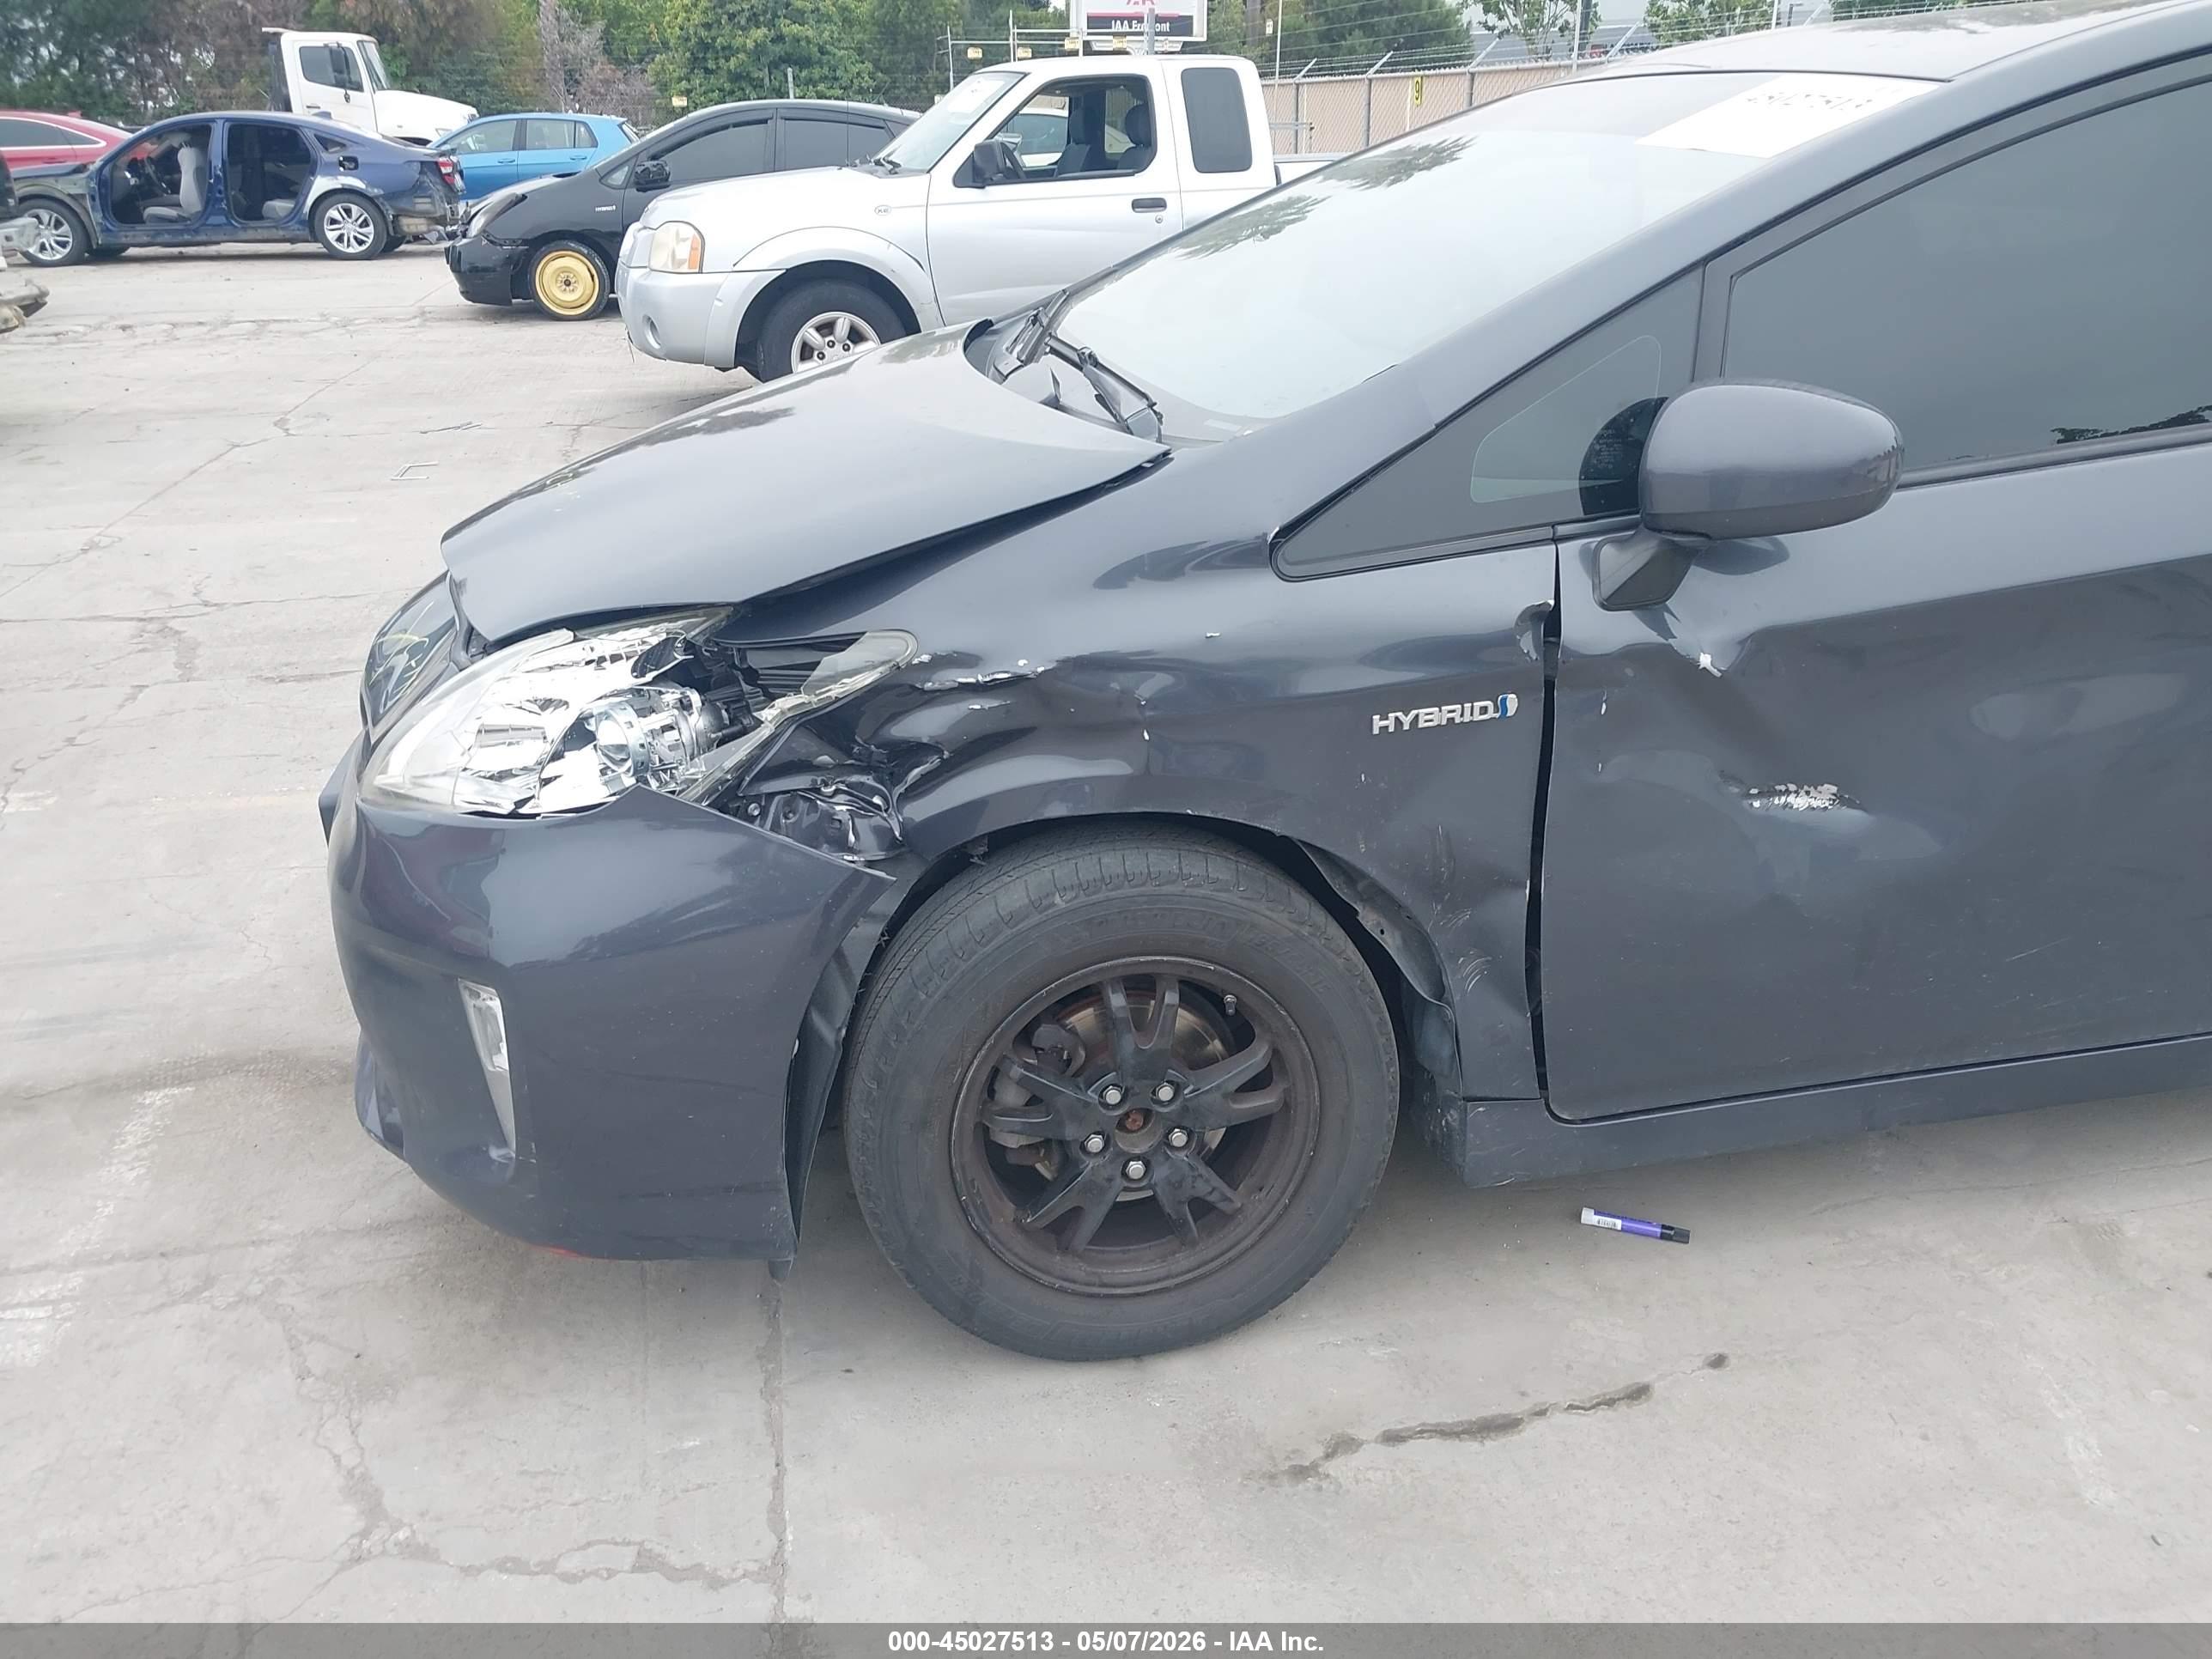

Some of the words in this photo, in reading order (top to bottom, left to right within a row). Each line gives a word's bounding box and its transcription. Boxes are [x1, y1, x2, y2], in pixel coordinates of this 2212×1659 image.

[1111, 19, 1129, 32] IAA
[1414, 79, 1420, 101] 9
[1371, 700, 1494, 736] HYBRID
